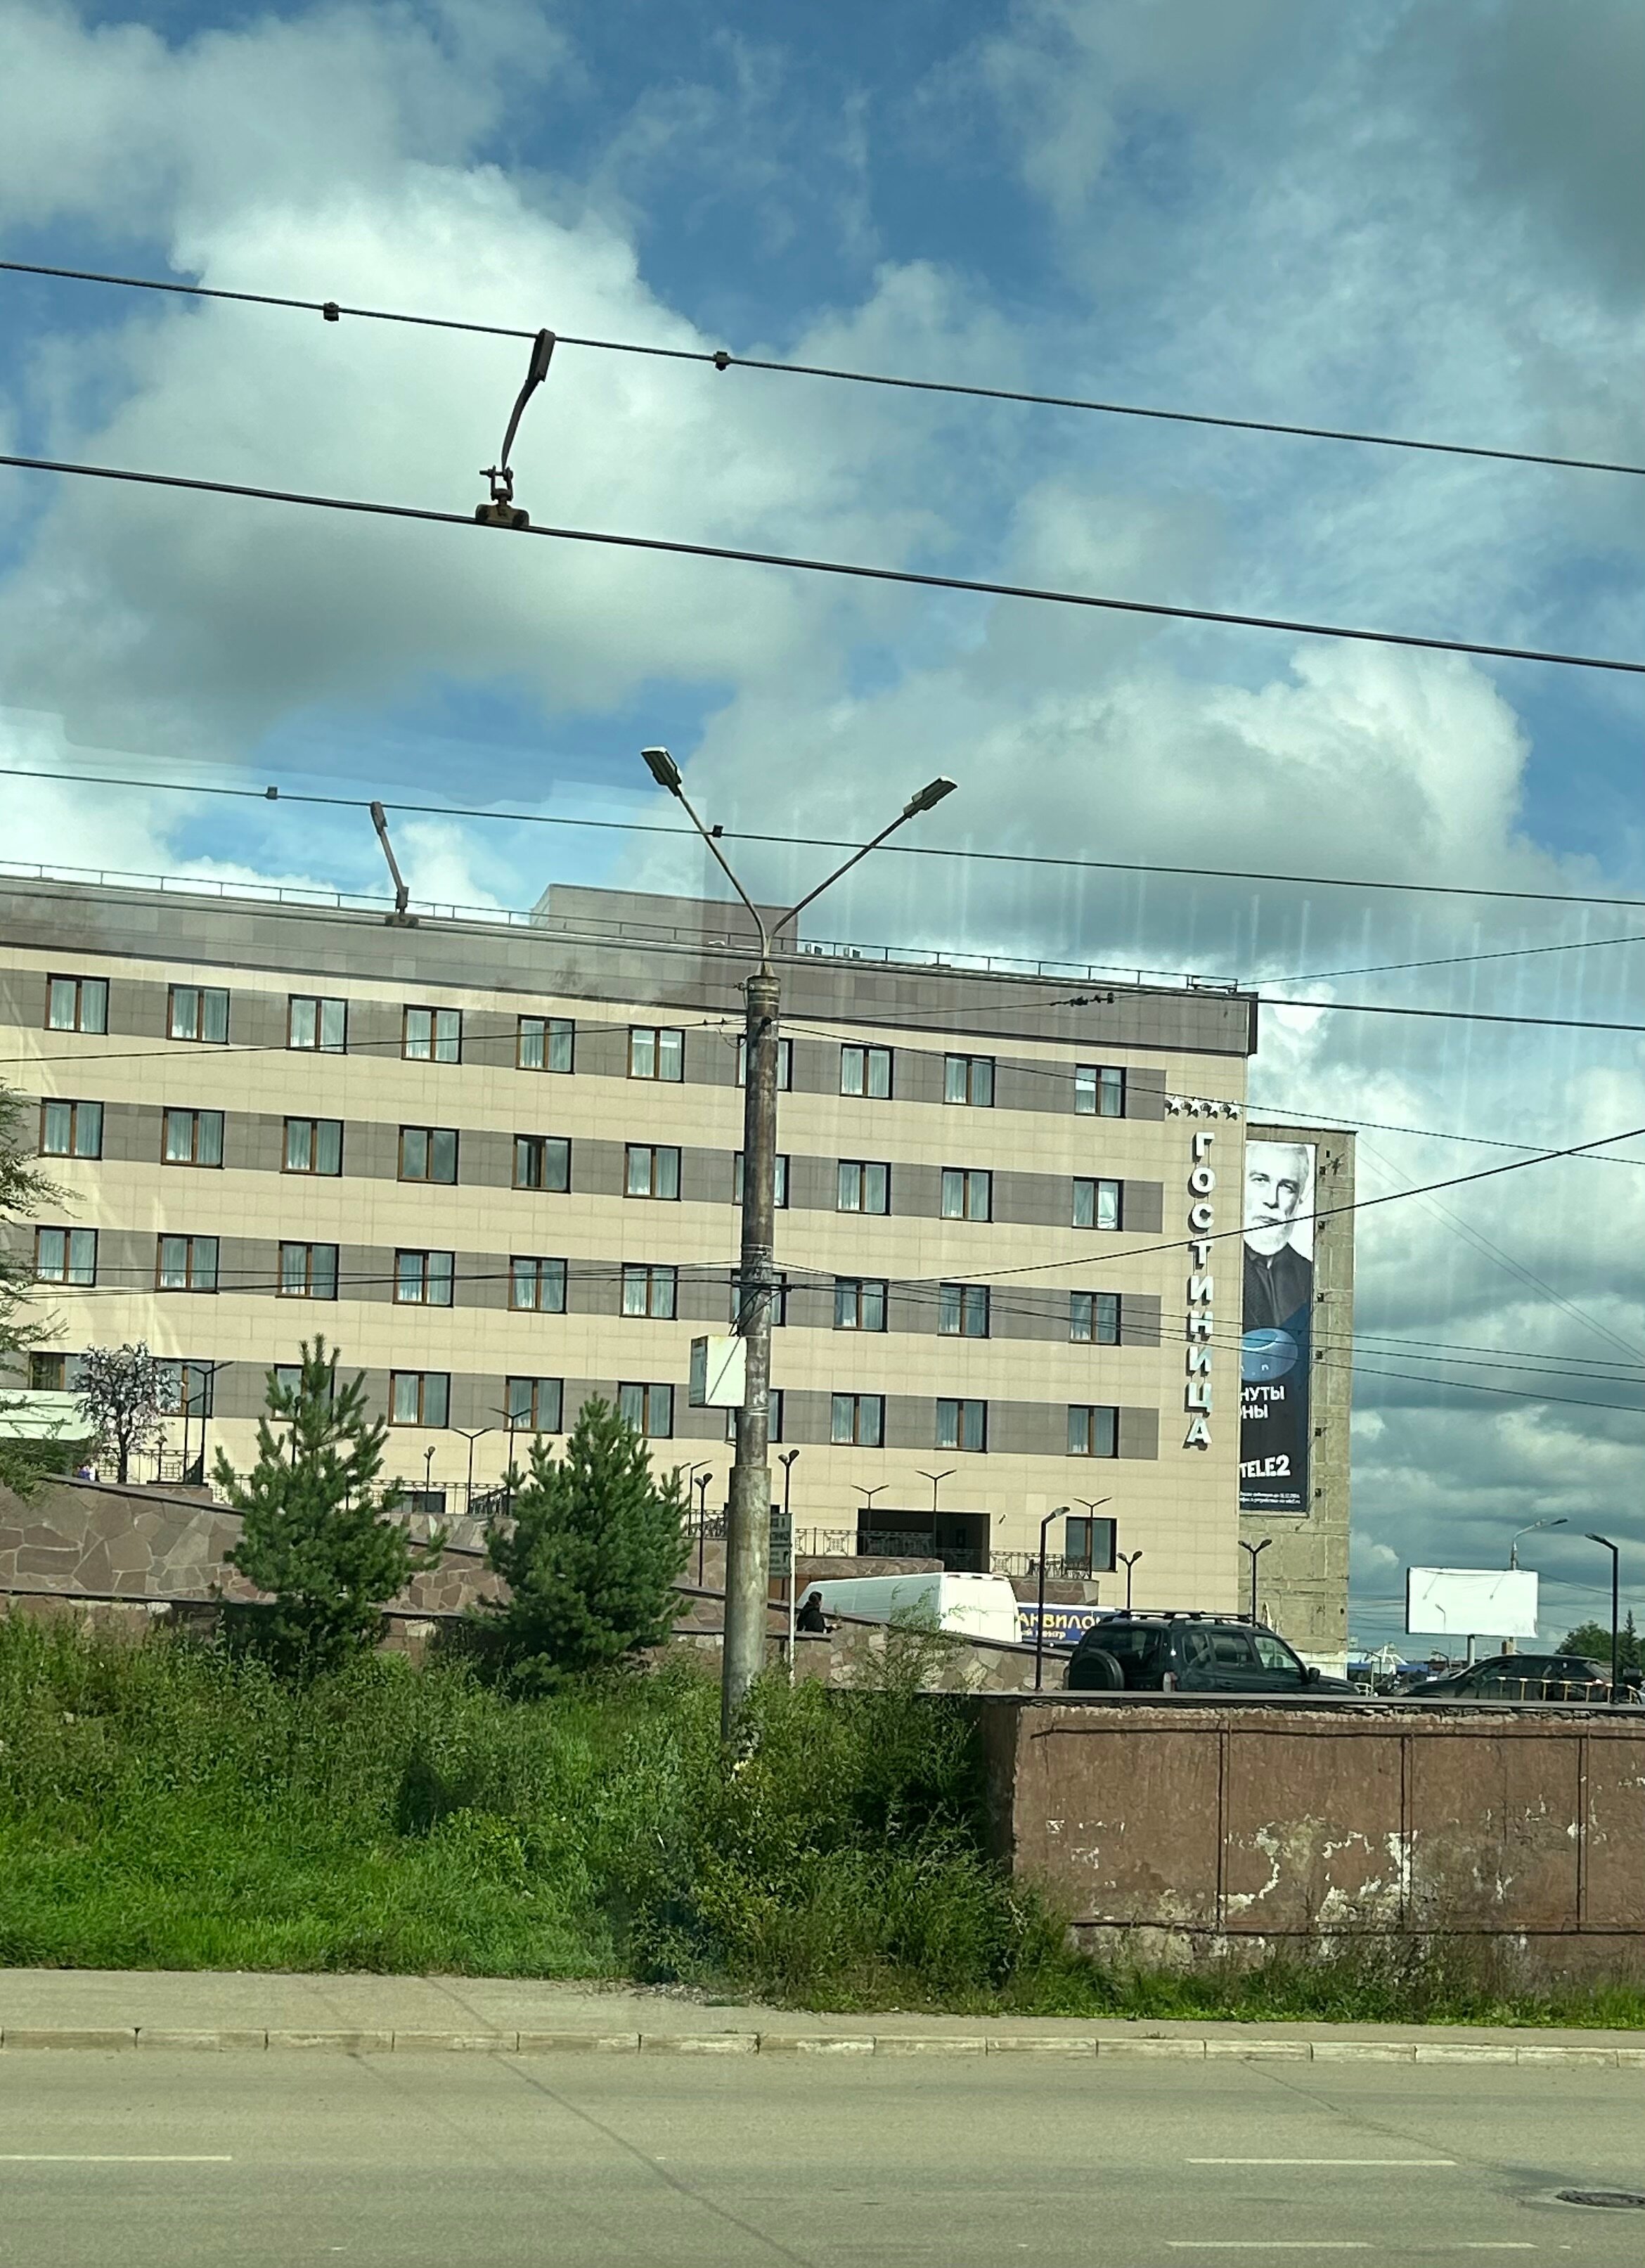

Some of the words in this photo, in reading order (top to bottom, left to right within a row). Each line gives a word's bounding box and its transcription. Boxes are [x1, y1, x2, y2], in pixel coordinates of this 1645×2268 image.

[1186, 1131, 1215, 1445] ГОСТИНИЦА
[1240, 1404, 1268, 1419] НЫ
[1239, 1454, 1291, 1478] TELE2
[1019, 1612, 1102, 1630] АКВИЛО
